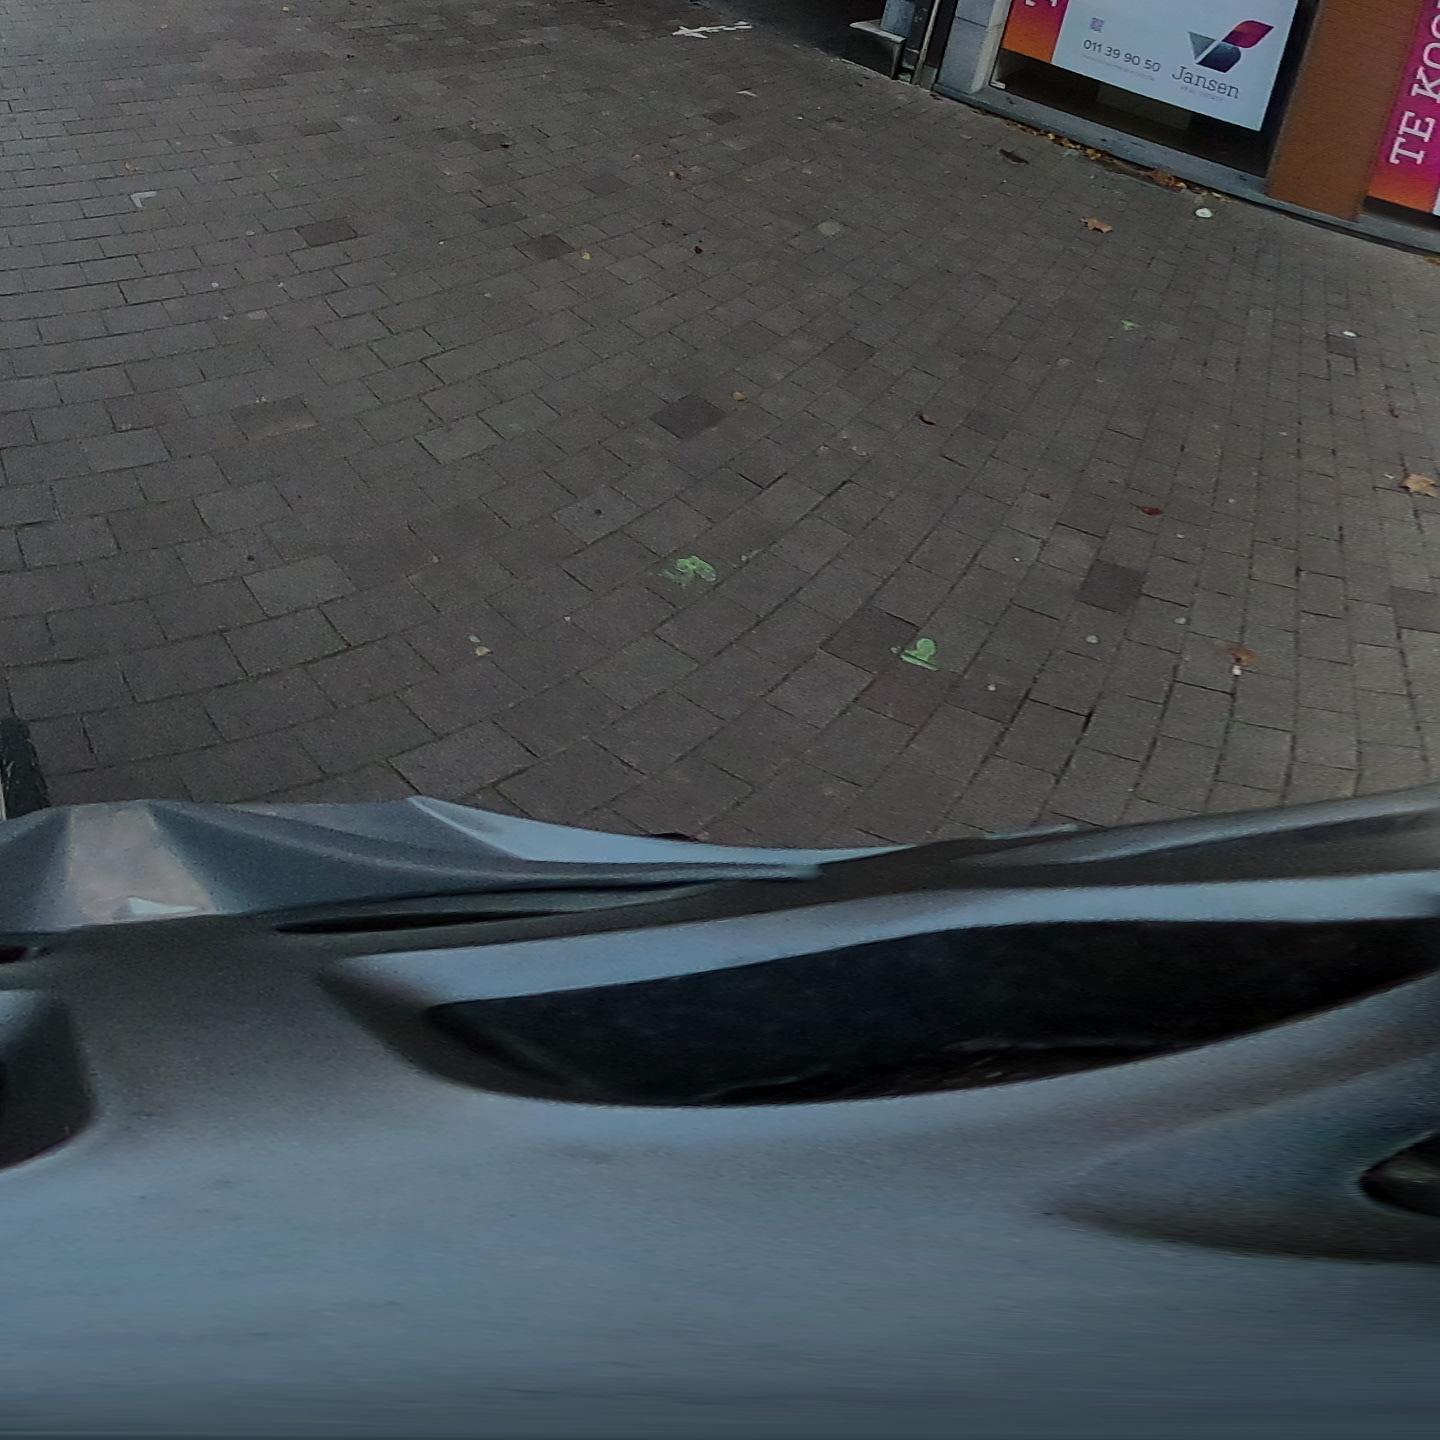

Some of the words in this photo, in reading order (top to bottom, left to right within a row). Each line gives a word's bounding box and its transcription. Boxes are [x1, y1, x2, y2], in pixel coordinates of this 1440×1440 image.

[1083, 39, 1103, 53] 011
[1104, 46, 1121, 60] 39
[1123, 52, 1140, 66] 90
[1143, 59, 1161, 73] 50
[1172, 66, 1239, 99] Jansen
[1389, 111, 1437, 165] TE
